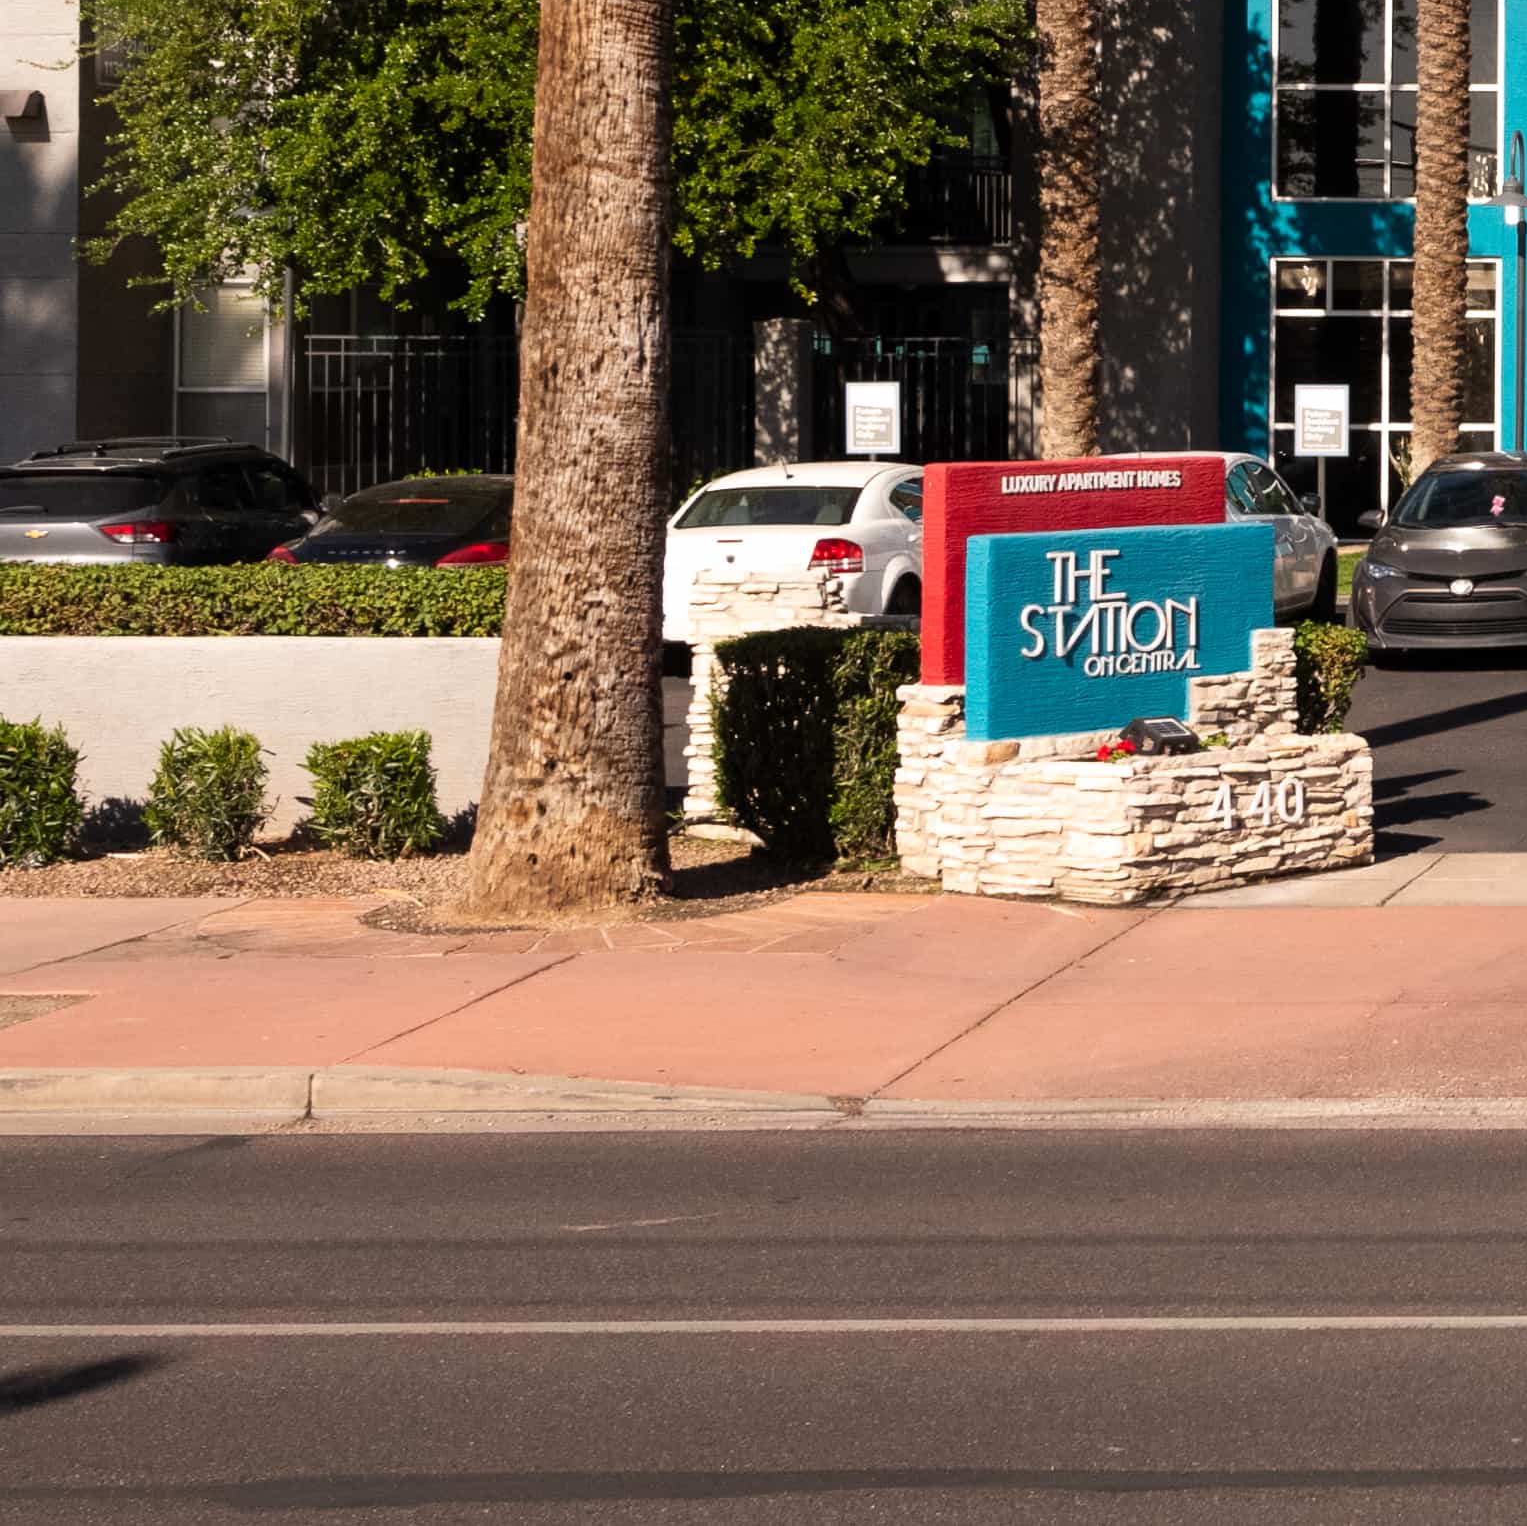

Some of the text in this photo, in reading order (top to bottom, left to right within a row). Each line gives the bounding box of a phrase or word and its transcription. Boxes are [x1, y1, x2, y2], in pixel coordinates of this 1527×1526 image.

[1001, 470, 1182, 494] LUXURY APARTMENT HOMES
[1046, 549, 1127, 603] THE
[1020, 596, 1197, 658] STATION
[1084, 648, 1201, 677] ON CENTRAL
